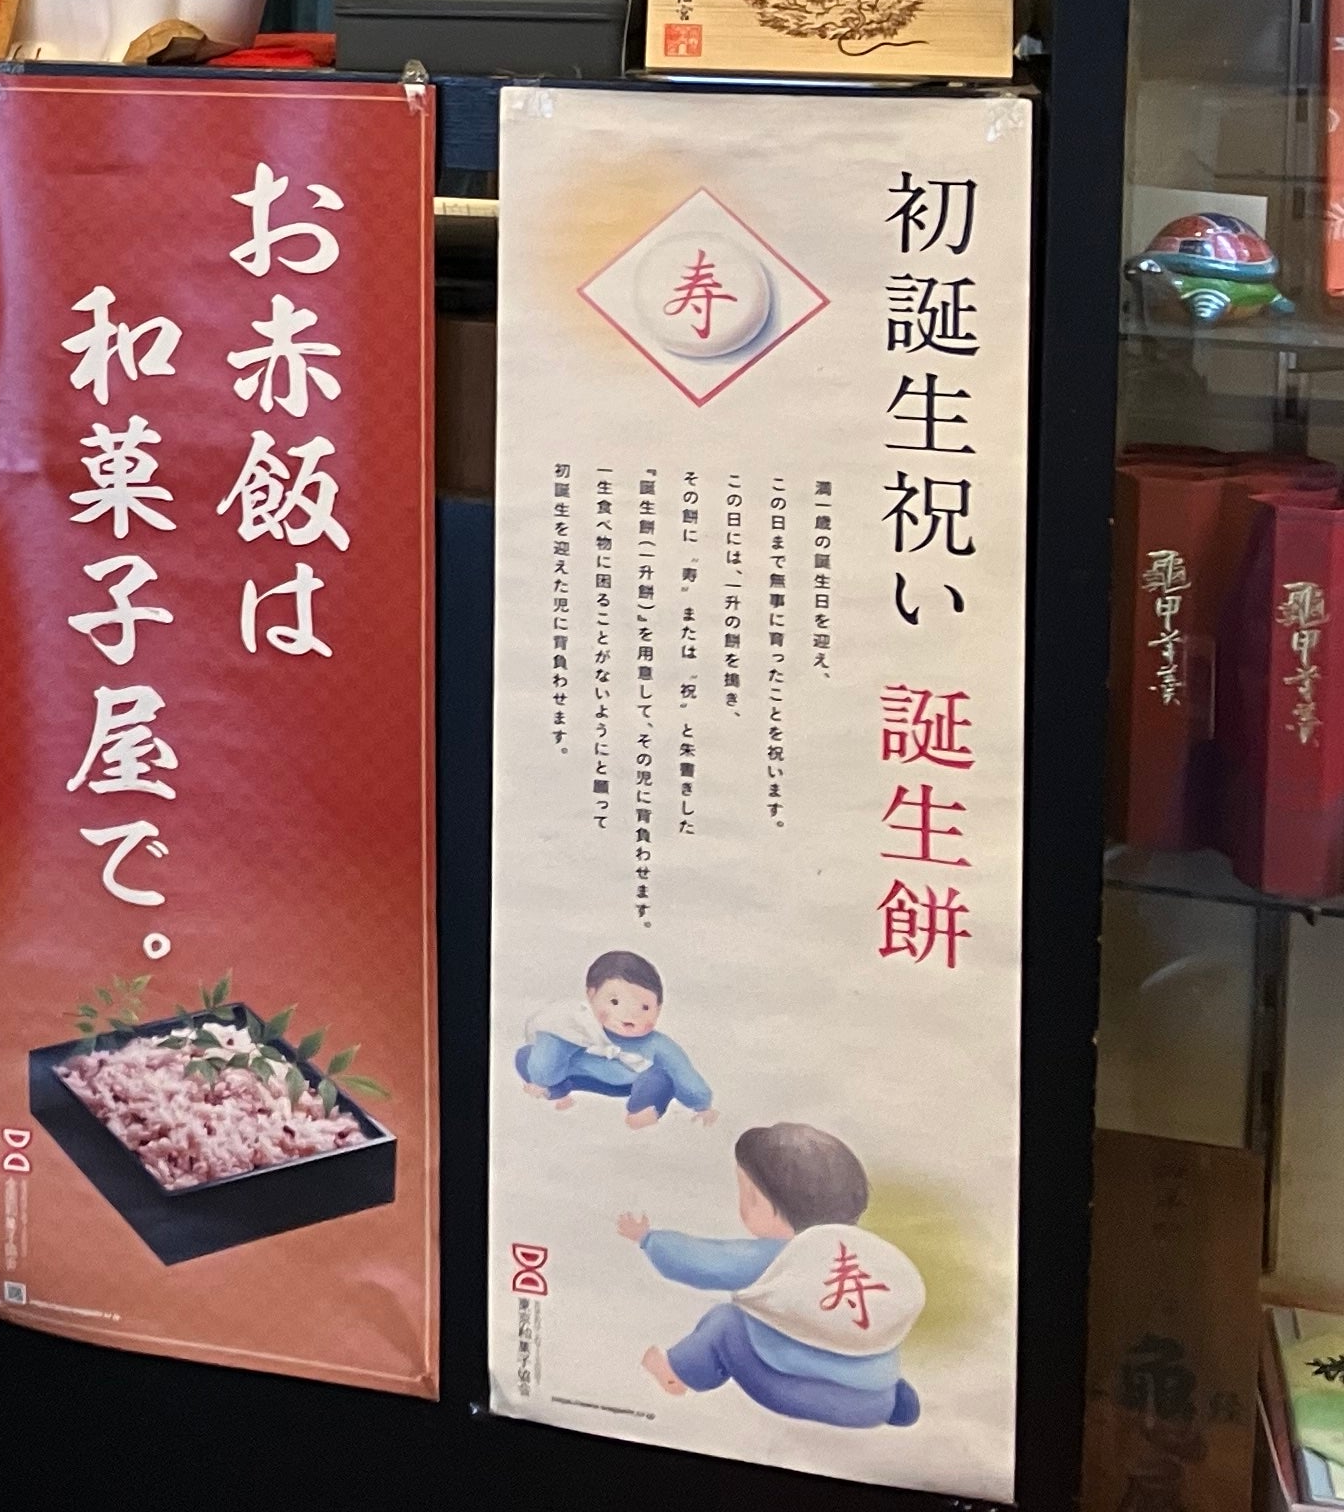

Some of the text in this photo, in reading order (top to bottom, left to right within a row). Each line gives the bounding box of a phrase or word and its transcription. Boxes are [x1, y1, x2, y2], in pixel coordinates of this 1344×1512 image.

[215, 160, 351, 661] お赤飯は
[663, 248, 738, 340] 寿
[59, 284, 180, 963] 和菓子屋で。
[874, 170, 982, 969] 初誕生祝い 誕生餅
[819, 1240, 891, 1330] 寿
